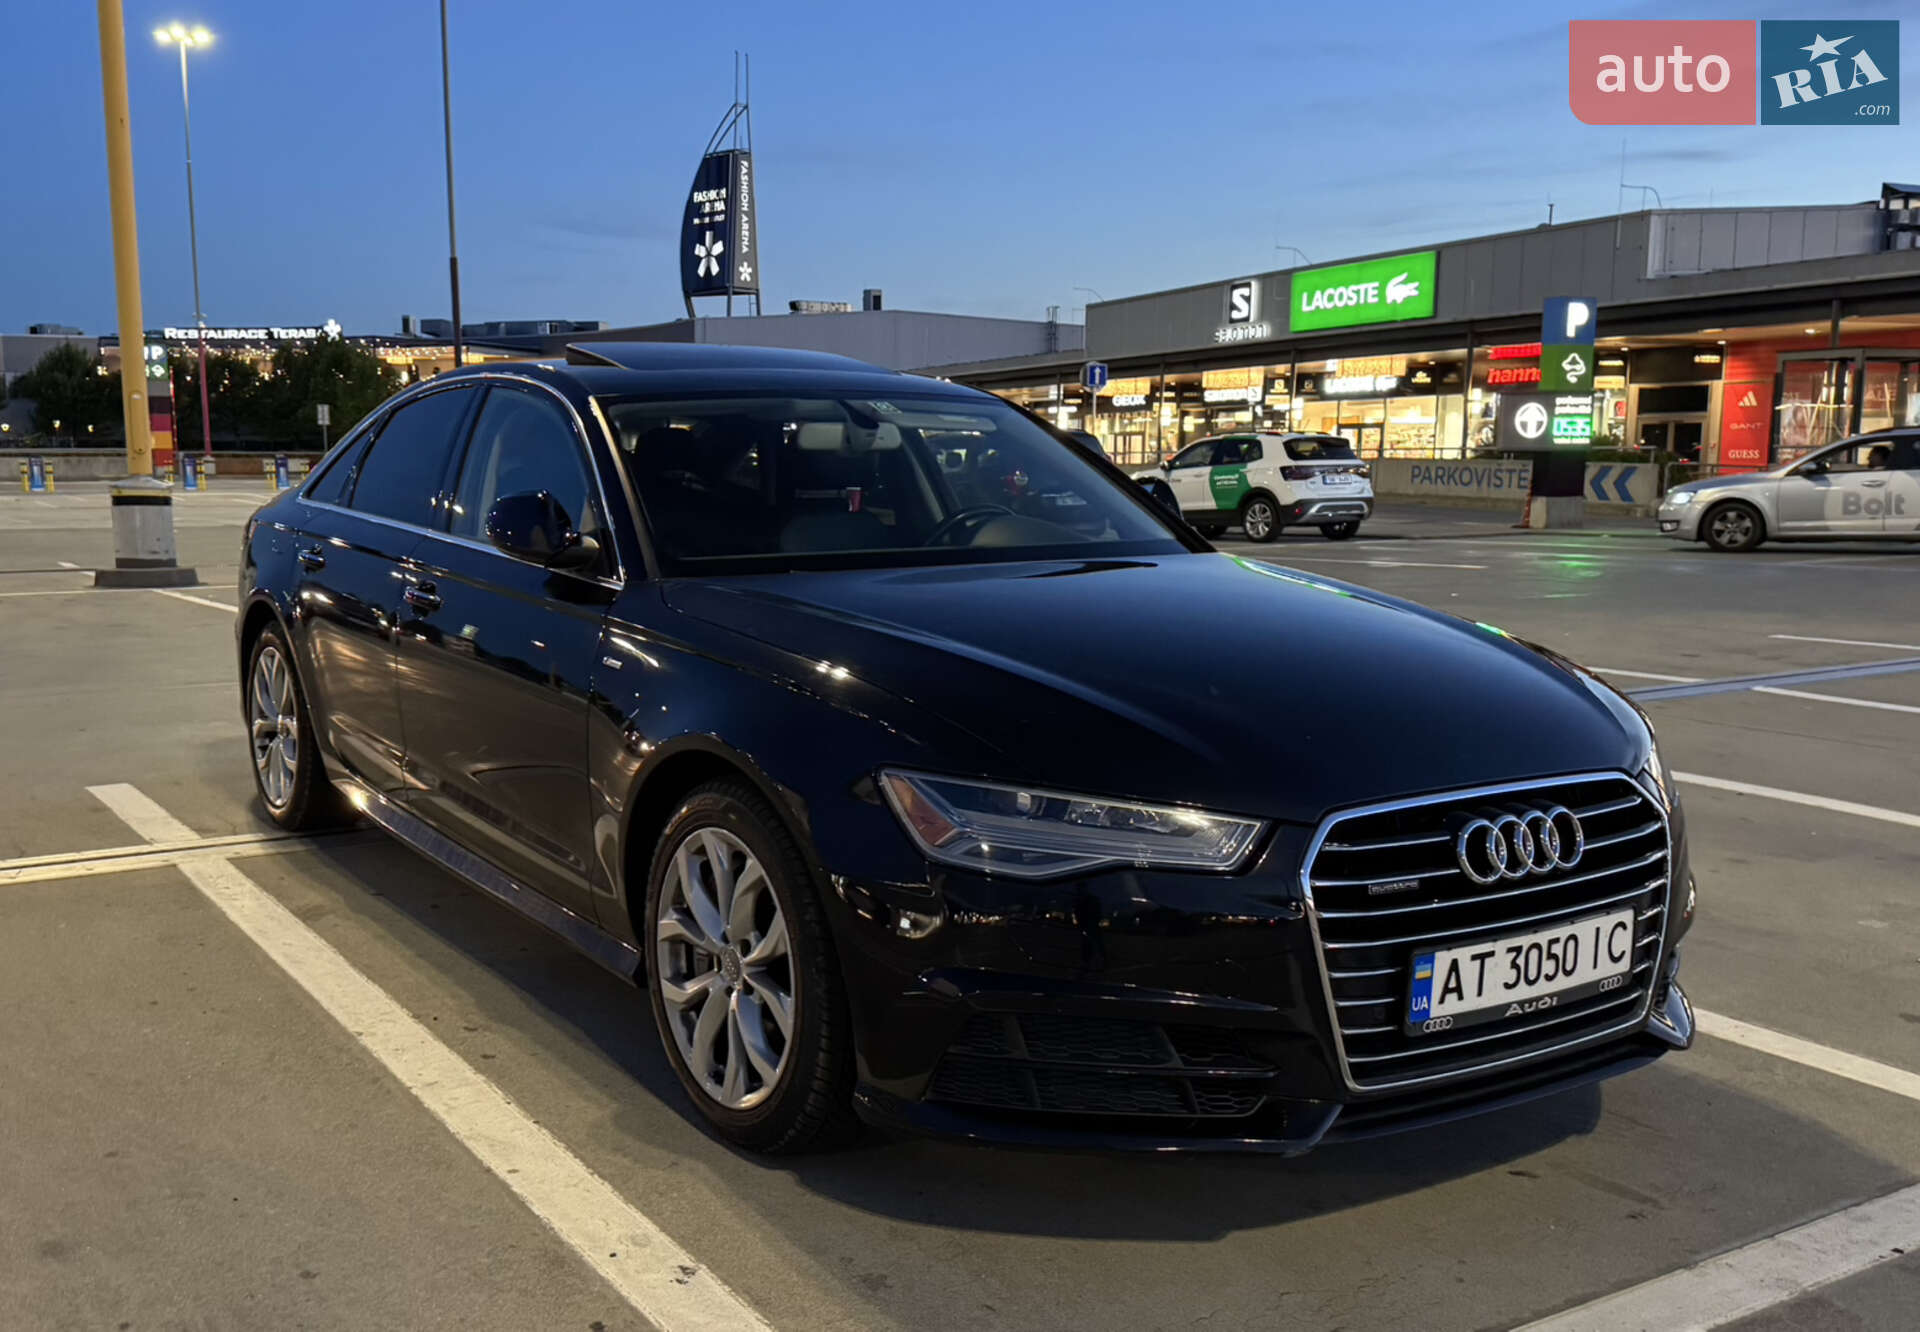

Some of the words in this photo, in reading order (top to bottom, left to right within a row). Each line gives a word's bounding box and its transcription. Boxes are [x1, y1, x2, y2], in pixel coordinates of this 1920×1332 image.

[740, 160, 749, 211] FASHION
[741, 214, 749, 253] ARENA
[1302, 282, 1380, 312] LACOSTE
[1566, 302, 1589, 338] P
[1728, 450, 1760, 459] GUESS
[1842, 490, 1906, 516] Bolt
[1438, 950, 1495, 1005] AT
[1503, 933, 1579, 991] 3050
[1593, 921, 1627, 970] IC
[1412, 997, 1429, 1012] UA
[1503, 996, 1558, 1017] Audi
